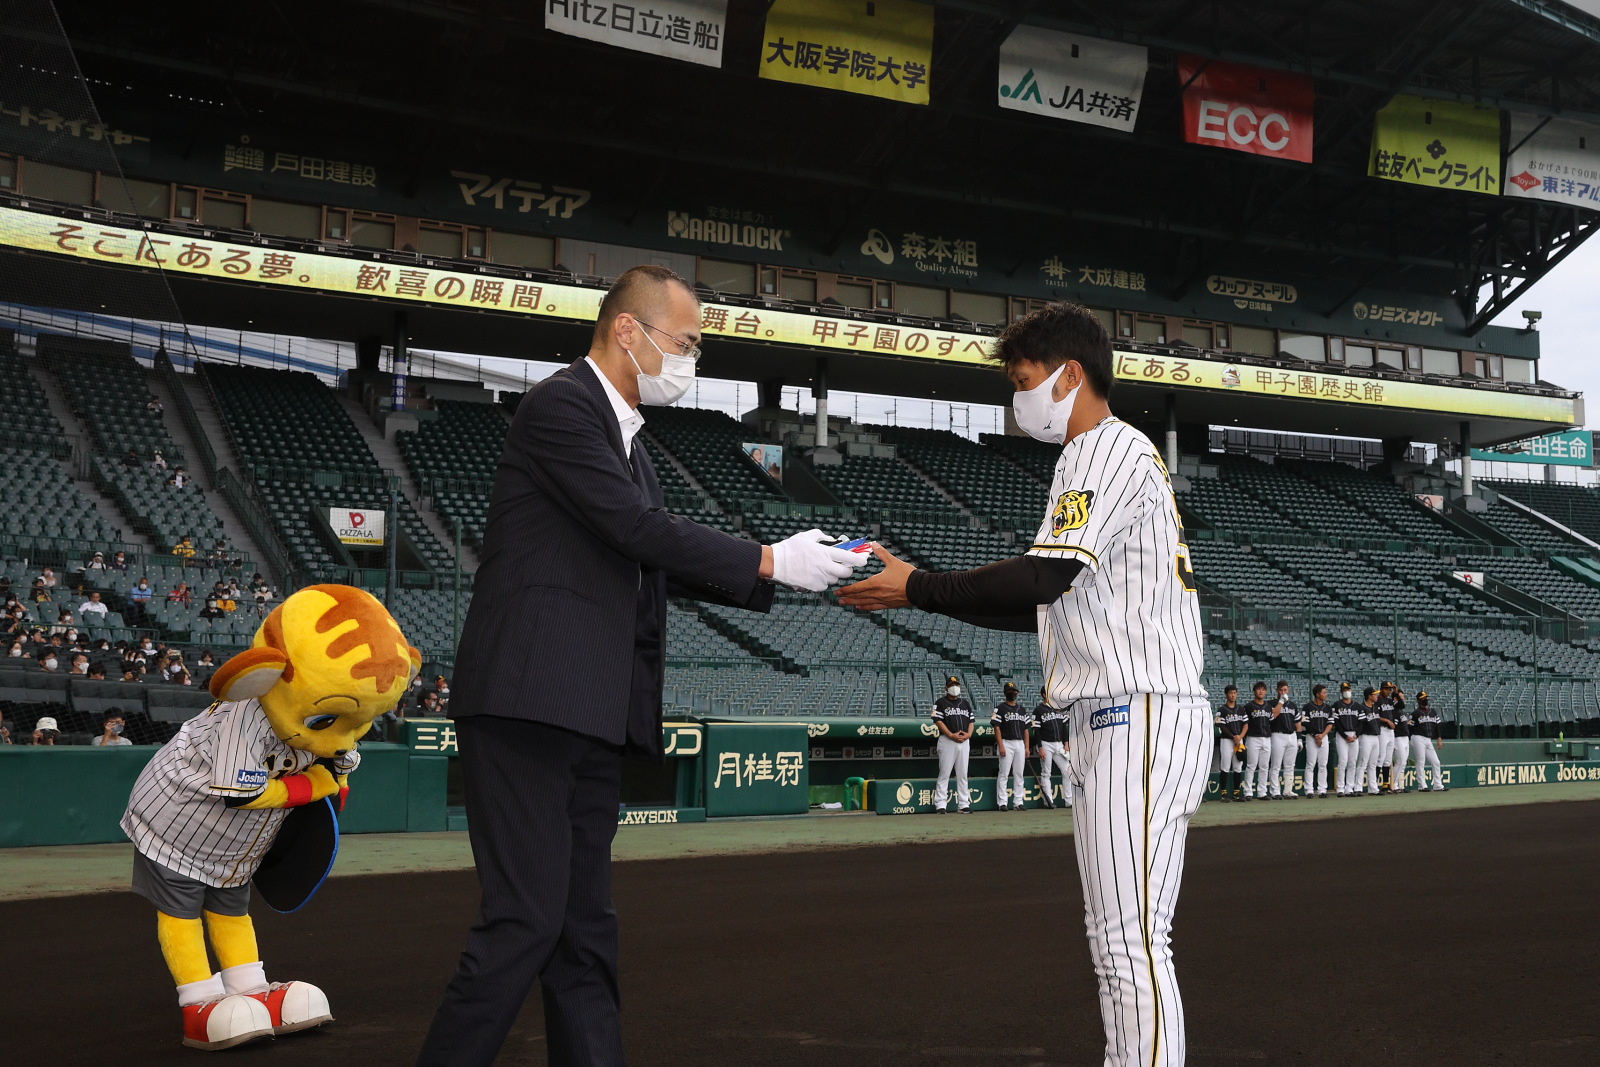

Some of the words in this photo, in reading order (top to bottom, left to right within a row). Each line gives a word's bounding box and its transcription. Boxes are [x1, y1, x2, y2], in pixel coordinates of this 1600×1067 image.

[766, 37, 926, 89] 大阪学院大学
[1048, 85, 1136, 121] JA共済
[0, 101, 151, 145] ートネイチャー
[1197, 100, 1290, 151] ECC
[271, 152, 377, 188] 戸田建設
[1375, 149, 1496, 190] 住友ベークライト
[1516, 176, 1537, 186] Toyal
[1528, 160, 1600, 181] おかげさまで90周
[449, 169, 592, 220] マイティア
[1542, 176, 1600, 203] 東洋アル
[901, 232, 978, 268] 森本組
[50, 223, 310, 283] そこにある夢。
[355, 264, 556, 312] 歓喜の瞬間。
[700, 306, 774, 337] 舞台。
[915, 260, 947, 275] Quality
[948, 264, 978, 279] Always
[1078, 265, 1146, 291] 大成建設
[1044, 279, 1069, 288] TAISEI
[1212, 276, 1294, 303] カップヌードル
[1249, 301, 1273, 312] 日清食品
[1369, 304, 1443, 327] シミズオクト
[1256, 370, 1384, 402] 甲子園歴史館
[868, 726, 895, 735] 住友生命
[1090, 708, 1129, 729] Joshin
[238, 771, 267, 784] Joshin
[714, 751, 804, 789] 月桂冠
[1487, 766, 1516, 785] LiVE
[1518, 765, 1547, 784] MAX
[1557, 763, 1587, 782] Joto
[893, 806, 915, 814] SOMPO
